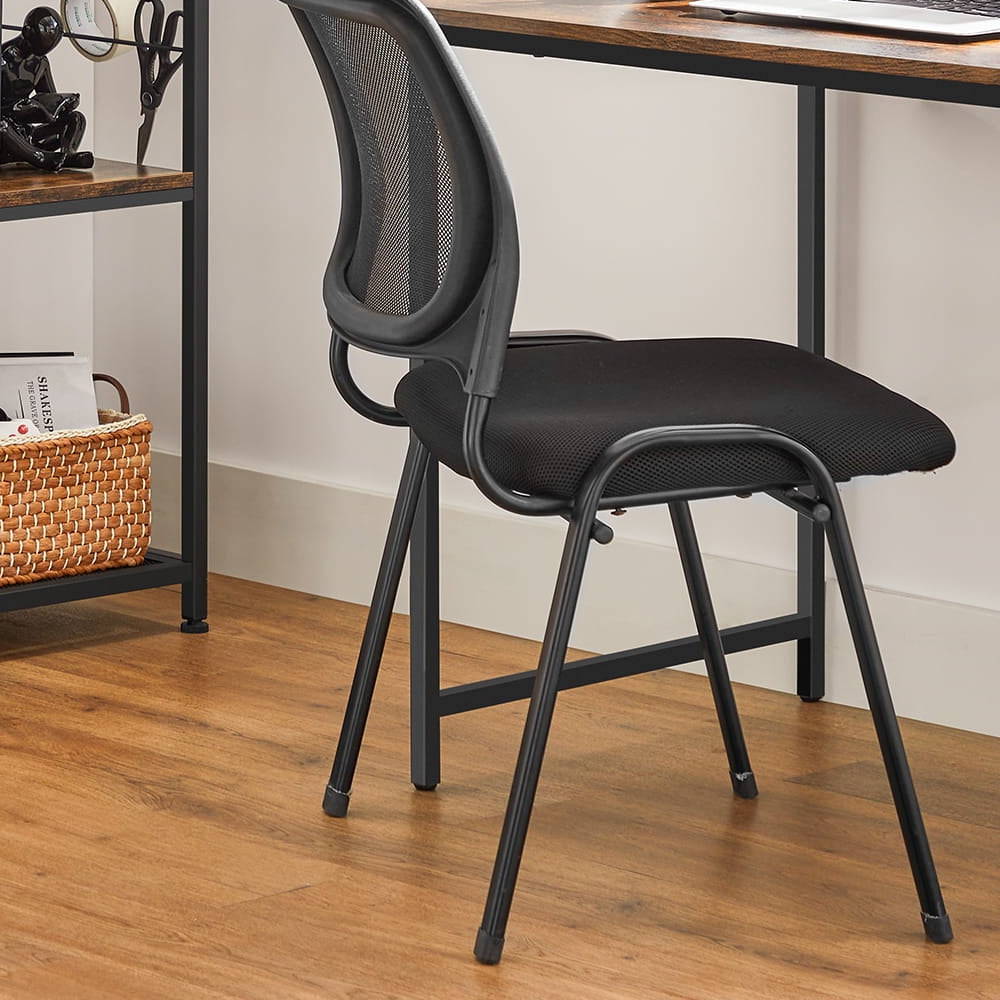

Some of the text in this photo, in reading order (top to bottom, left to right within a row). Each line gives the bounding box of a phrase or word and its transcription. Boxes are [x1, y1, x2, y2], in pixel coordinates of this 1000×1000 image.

[27, 381, 35, 395] THE
[29, 395, 38, 419] GRAVE
[37, 376, 54, 432] SHAKESP
